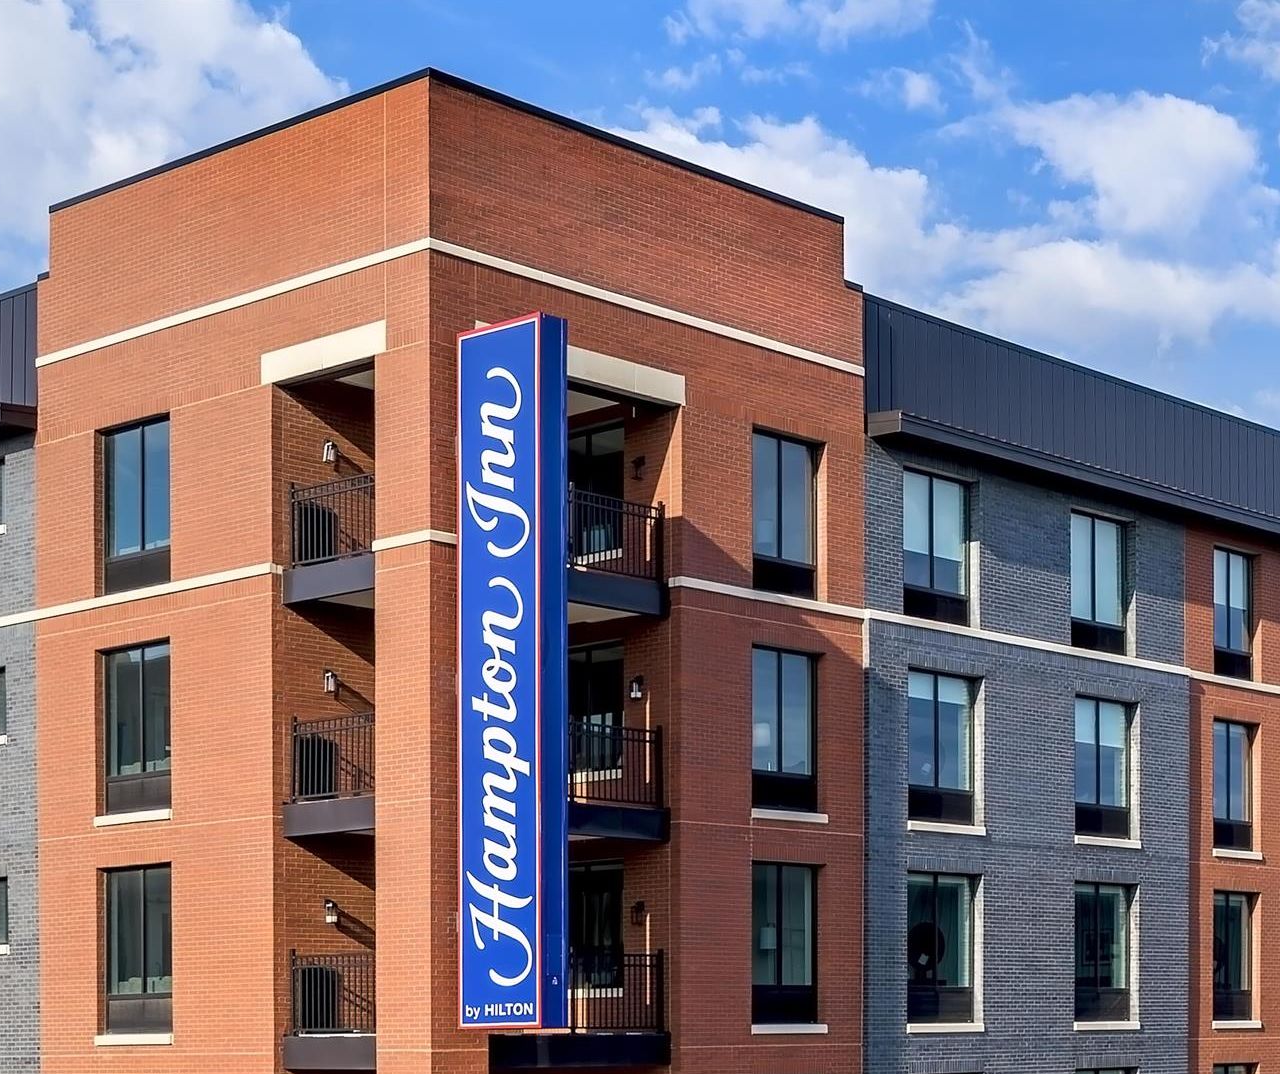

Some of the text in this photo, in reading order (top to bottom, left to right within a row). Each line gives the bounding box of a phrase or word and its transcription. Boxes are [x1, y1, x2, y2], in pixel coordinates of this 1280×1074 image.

[465, 366, 533, 987] Hampton Inn
[465, 1002, 534, 1020] by HILTON
